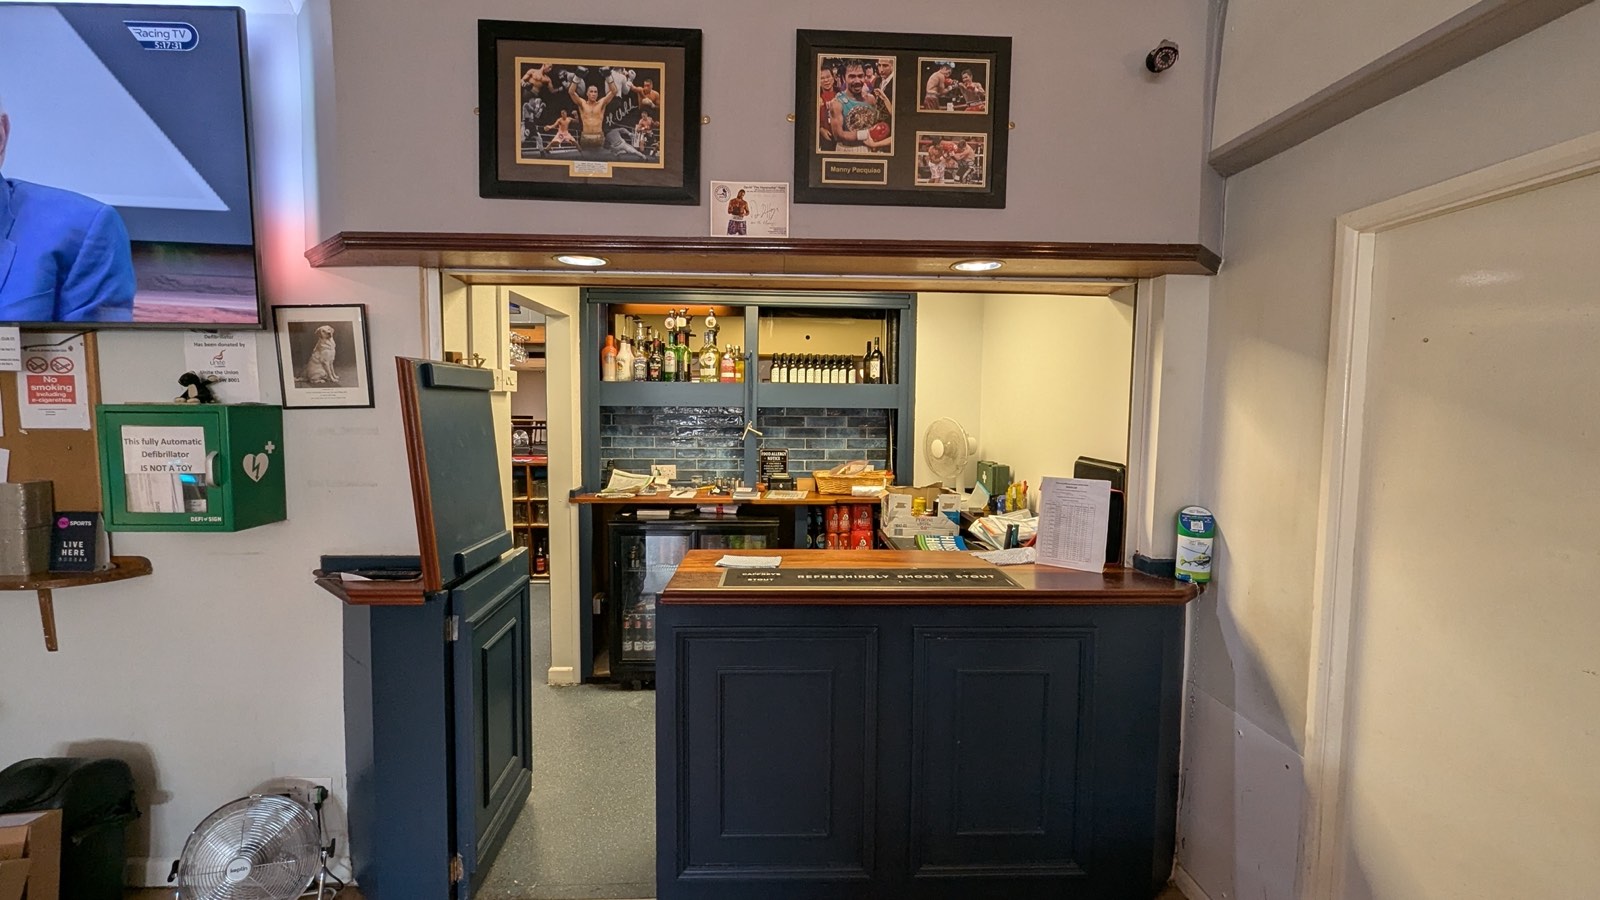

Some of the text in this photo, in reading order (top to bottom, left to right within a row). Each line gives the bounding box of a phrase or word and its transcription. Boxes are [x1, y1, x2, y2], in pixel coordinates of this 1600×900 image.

[132, 28, 186, 40] Racing TV
[154, 41, 182, 49] 5:17:31
[830, 166, 881, 174] Manny Pacquiao
[43, 375, 58, 383] No
[31, 384, 73, 392] smoking
[141, 438, 159, 446] fully
[160, 438, 202, 446] Automatic
